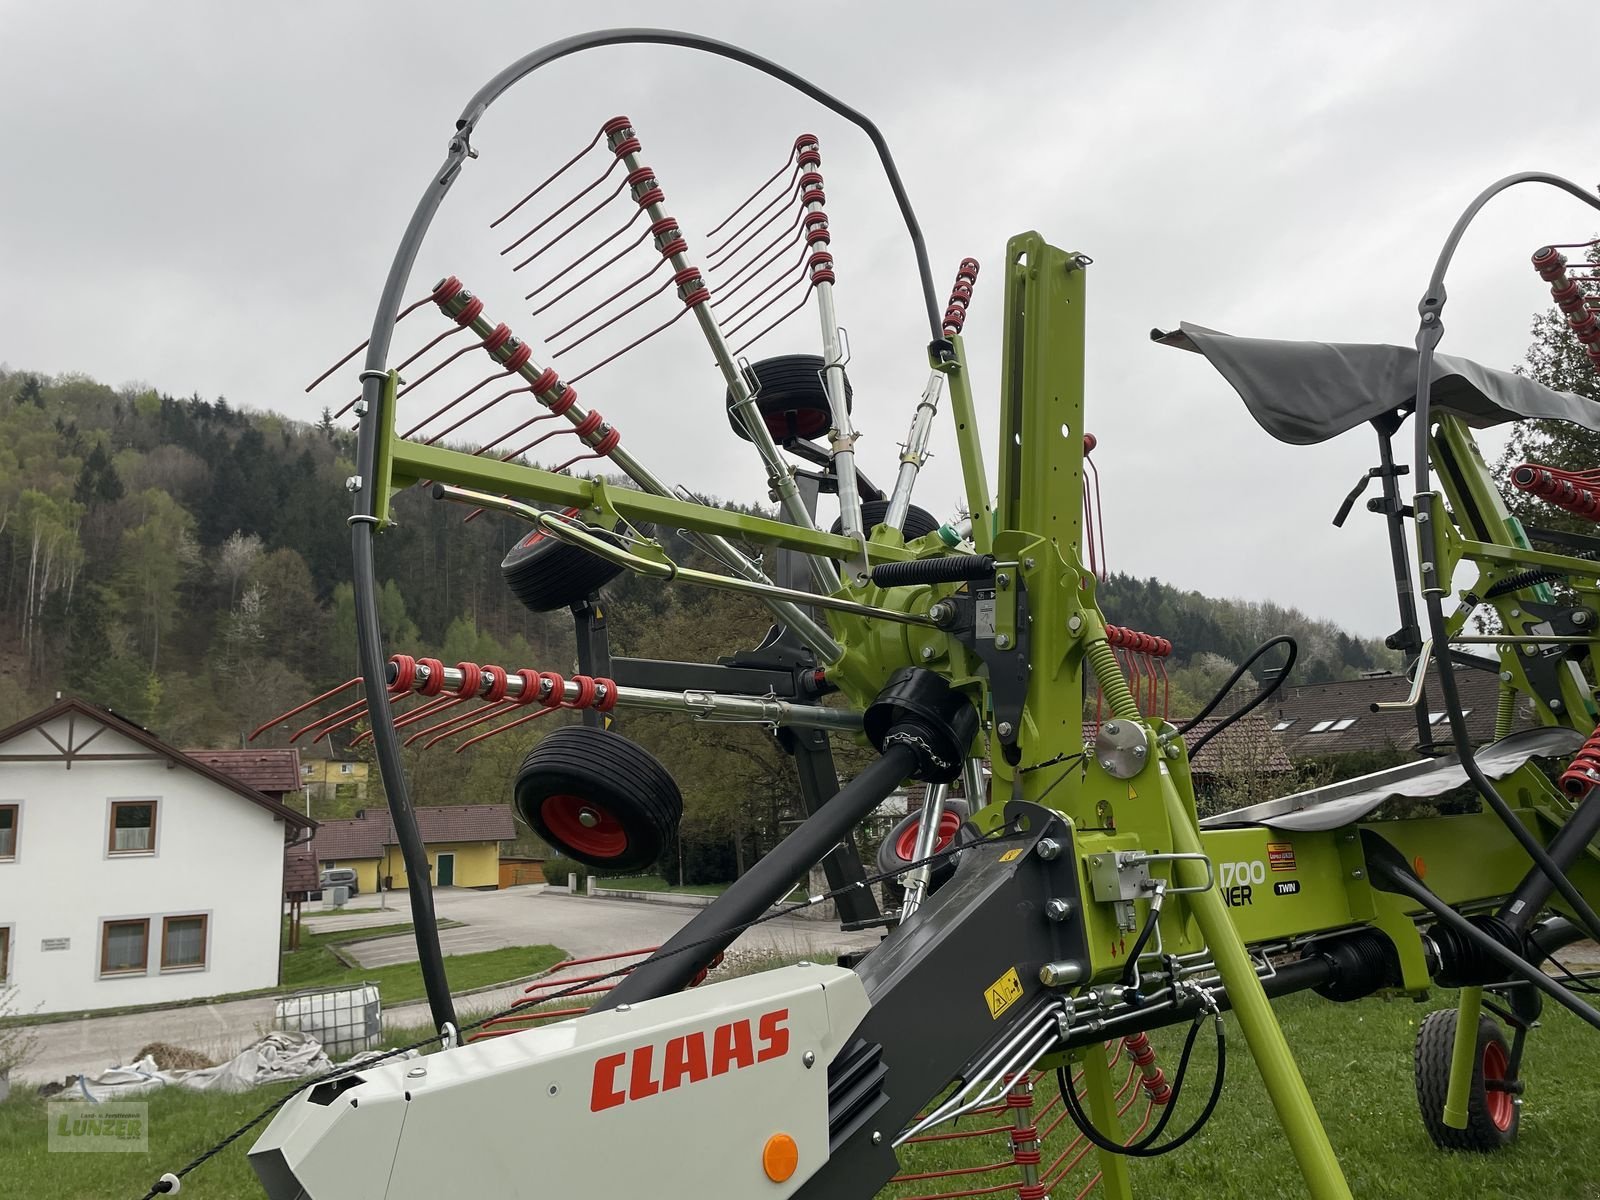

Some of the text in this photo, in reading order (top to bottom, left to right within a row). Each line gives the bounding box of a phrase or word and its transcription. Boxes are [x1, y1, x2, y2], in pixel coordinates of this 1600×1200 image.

[1219, 860, 1265, 888] 1700
[1220, 885, 1252, 907] NER
[1278, 882, 1296, 893] TWIN
[590, 1008, 790, 1112] CLAAS
